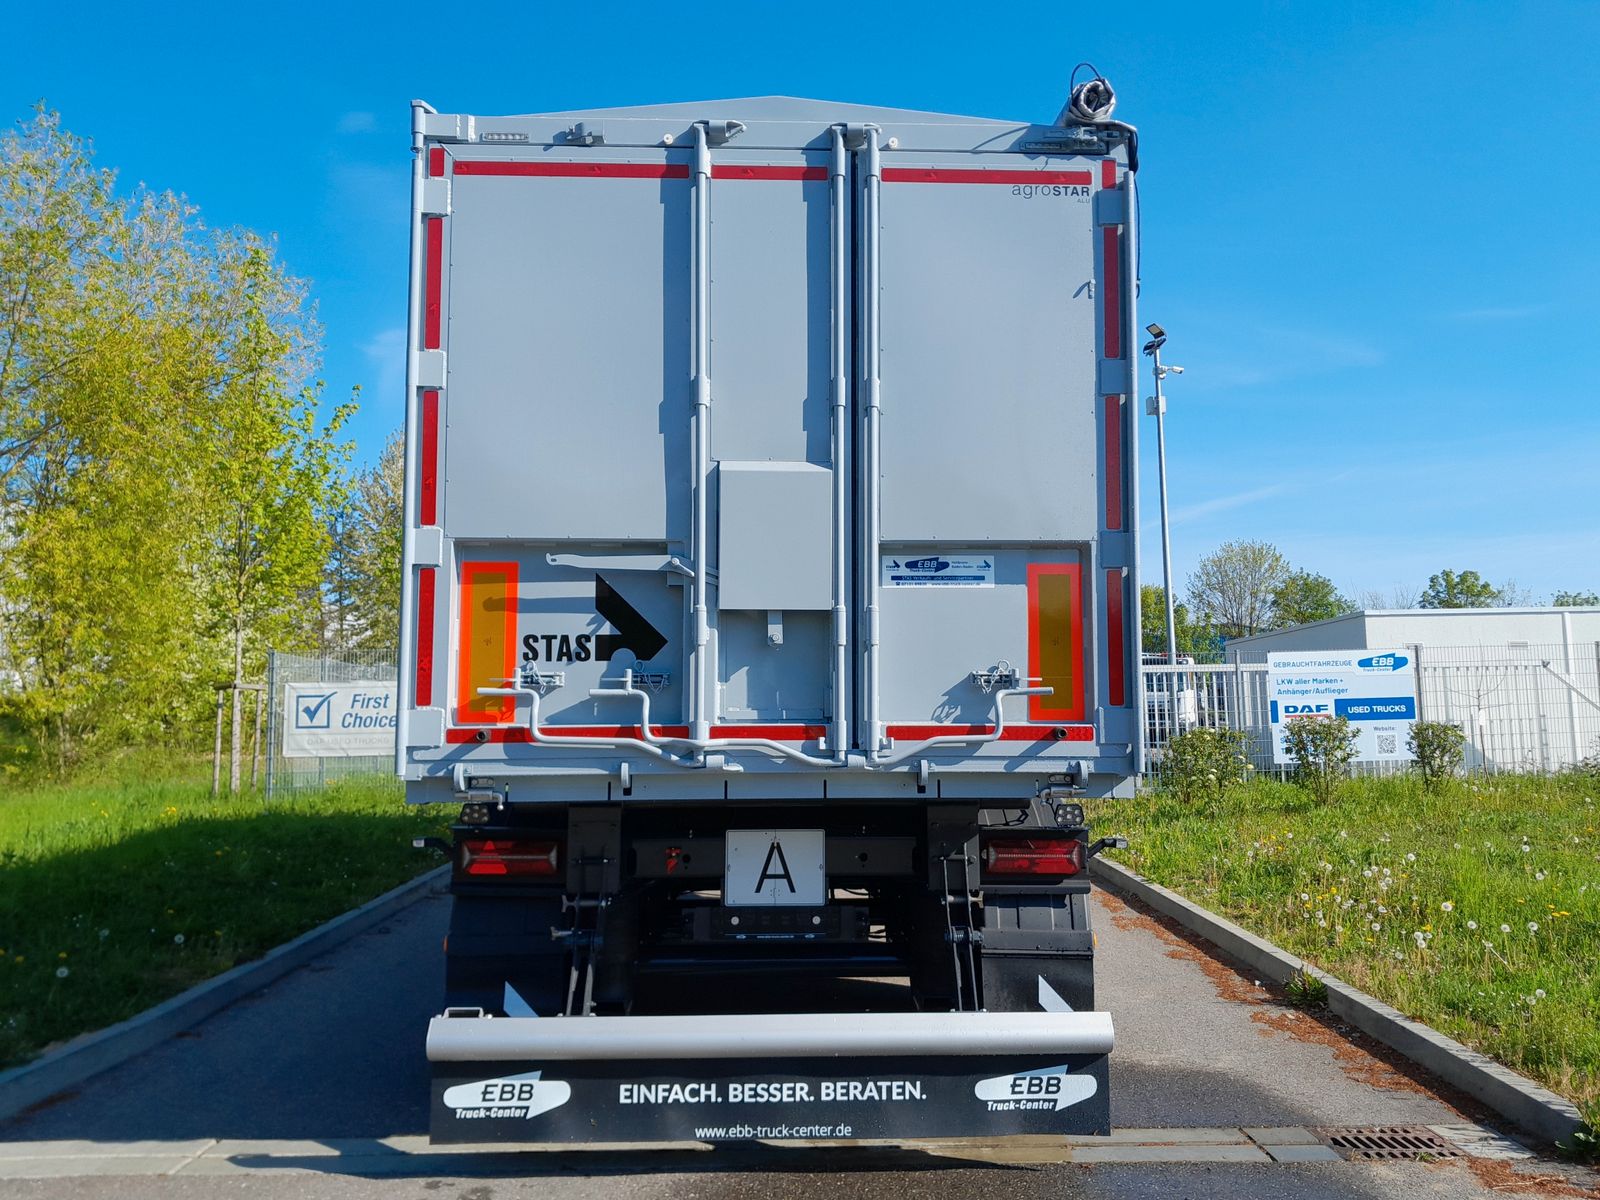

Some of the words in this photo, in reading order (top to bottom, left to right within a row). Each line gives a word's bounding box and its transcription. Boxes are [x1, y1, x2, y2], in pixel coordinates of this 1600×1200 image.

[1011, 184, 1090, 200] agroSTAR
[917, 560, 938, 568] EBB
[522, 634, 592, 662] STAS
[1273, 659, 1353, 668] GEBRAUCHTFAHRZEUGE
[1371, 656, 1395, 667] EBB
[1276, 678, 1293, 686] LKW
[1312, 677, 1338, 685] Marken
[1277, 687, 1349, 695] Anhänger/Auflieger
[351, 693, 390, 709] First
[1284, 704, 1329, 714] DAF
[1347, 705, 1371, 714] USED
[1372, 704, 1407, 713] TRUCKS
[341, 712, 397, 729] Choice
[754, 841, 796, 893] A
[481, 1083, 535, 1102] EBB
[618, 1083, 723, 1104] EINFACH.
[728, 1082, 815, 1103] BESSER.
[820, 1081, 927, 1101] BERATEN.
[1010, 1076, 1062, 1095] EBB
[987, 1099, 1055, 1111] Truck-Center
[455, 1107, 527, 1119] Truck-Center
[695, 1122, 852, 1138] www.ebb-truck-center.de
